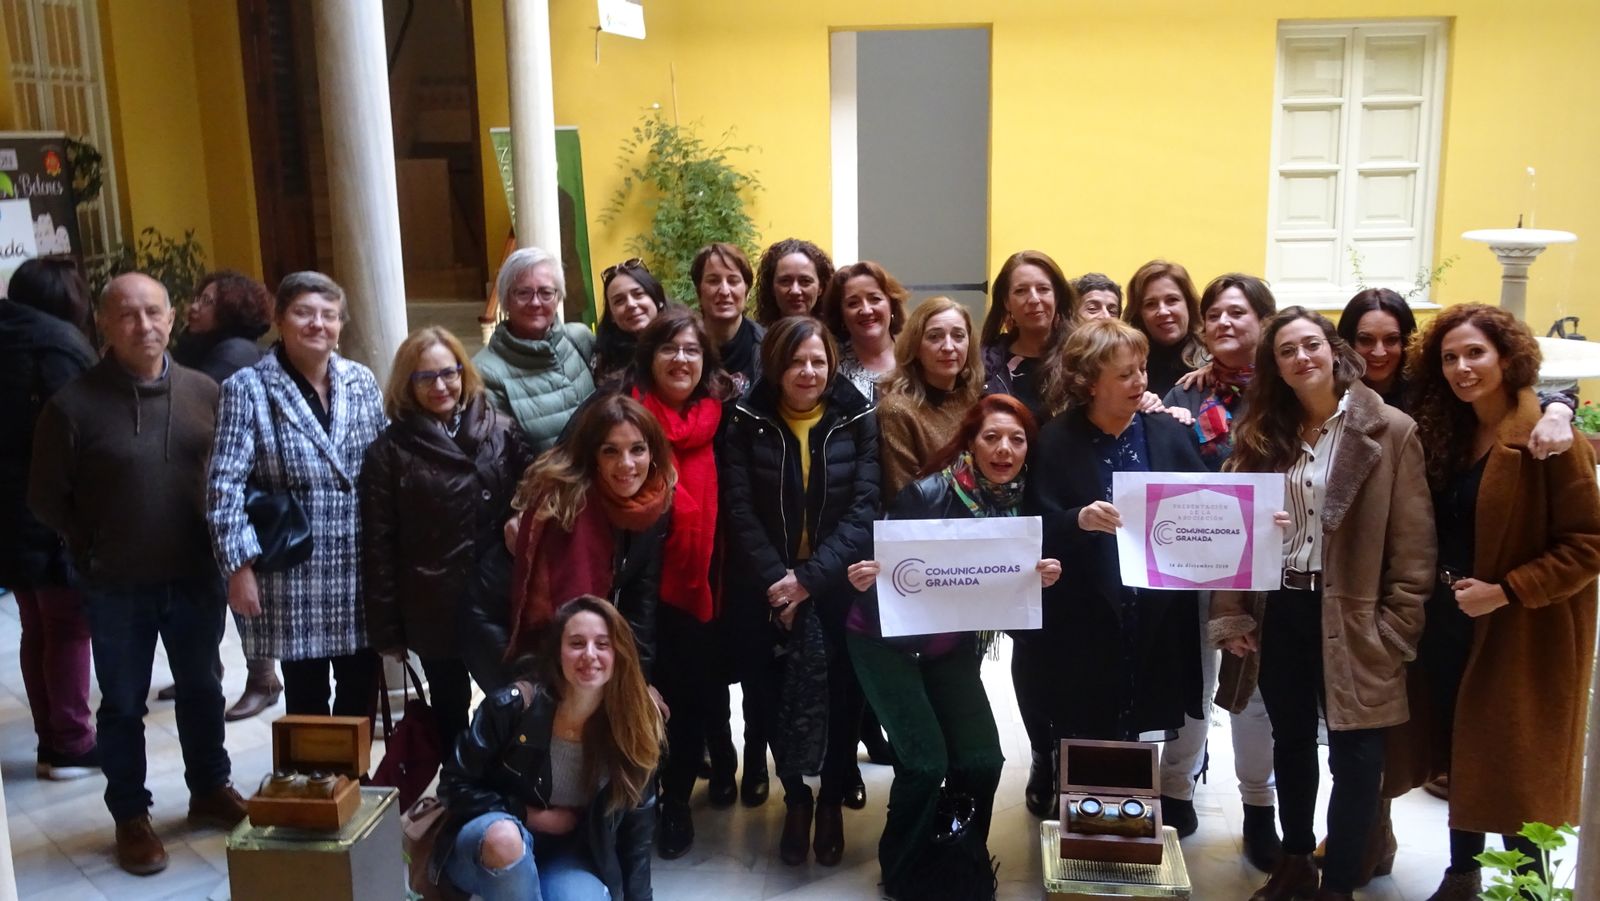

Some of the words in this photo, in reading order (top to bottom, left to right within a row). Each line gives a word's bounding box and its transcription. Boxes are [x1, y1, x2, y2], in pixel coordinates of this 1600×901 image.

[1175, 527, 1240, 535] COMUNICADORAS
[925, 565, 1021, 576] COMUNICADORAS
[925, 577, 980, 588] GRANADA
